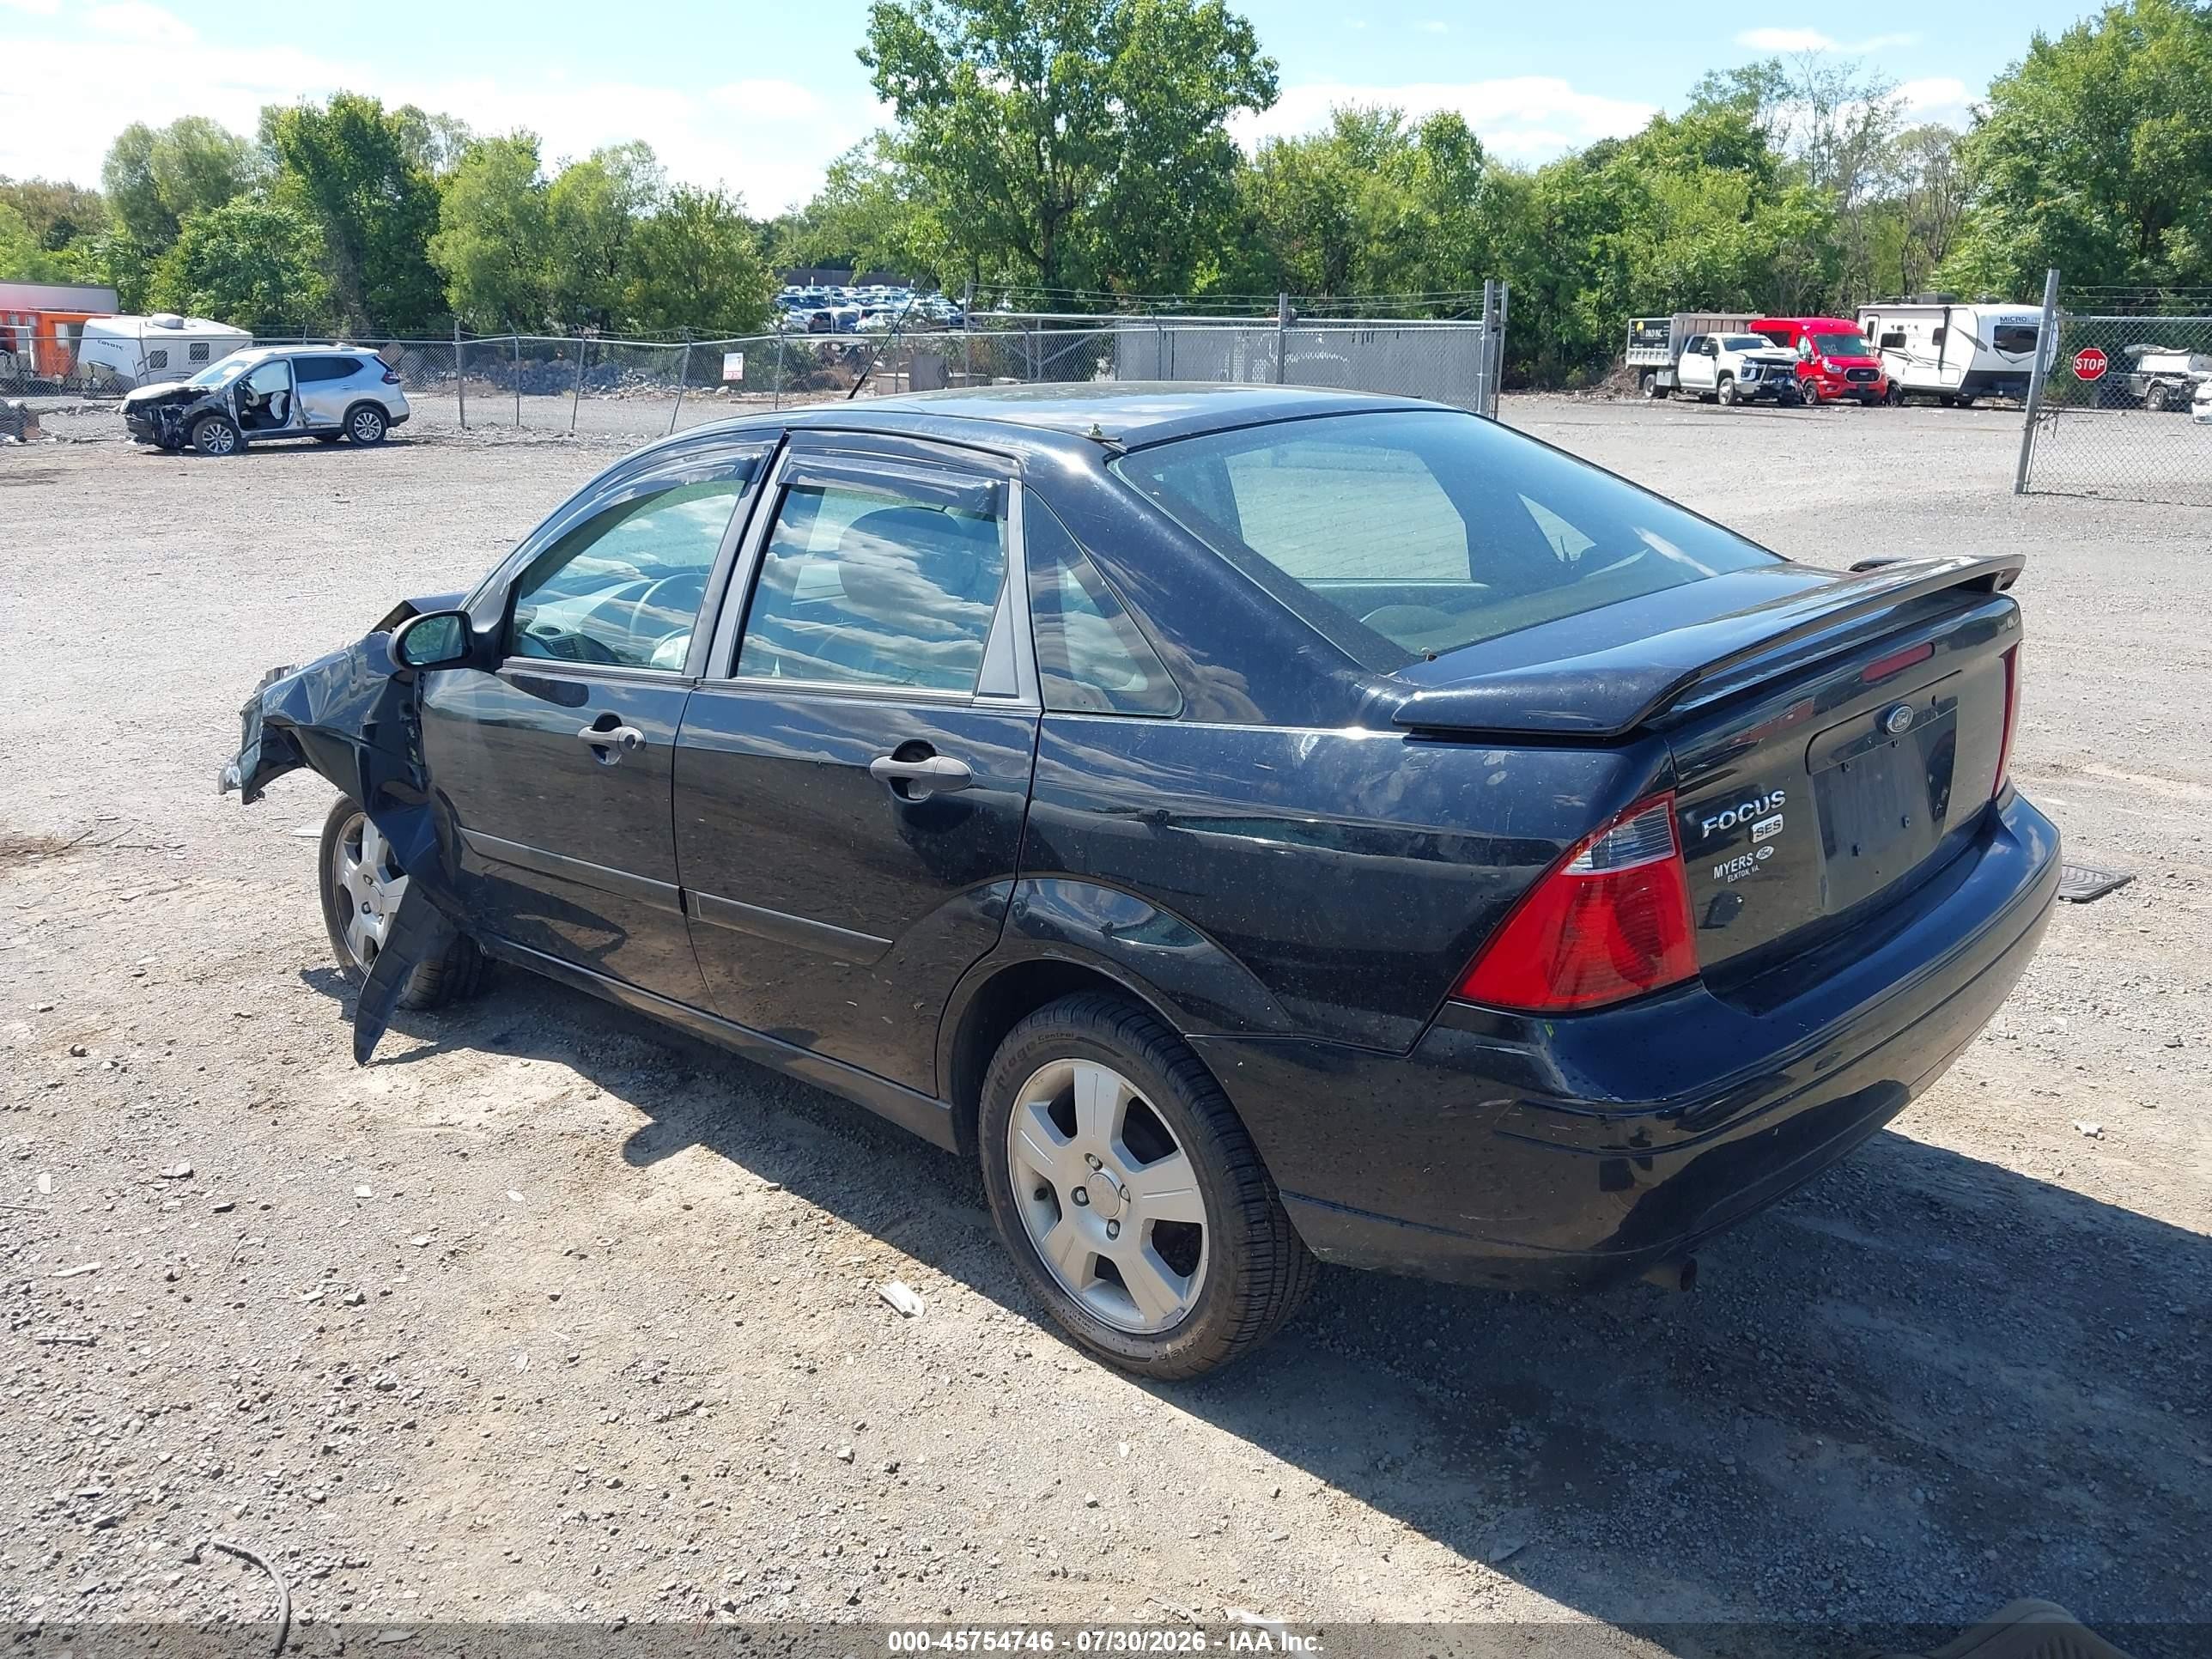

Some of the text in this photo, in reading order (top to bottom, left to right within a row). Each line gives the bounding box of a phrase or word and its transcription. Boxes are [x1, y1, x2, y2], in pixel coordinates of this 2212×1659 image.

[97, 339, 125, 351] COYOTE
[2075, 357, 2106, 371] STOP
[1700, 789, 1786, 839] FOCUS
[1755, 818, 1781, 839] SES
[1713, 852, 1754, 880] MYERS
